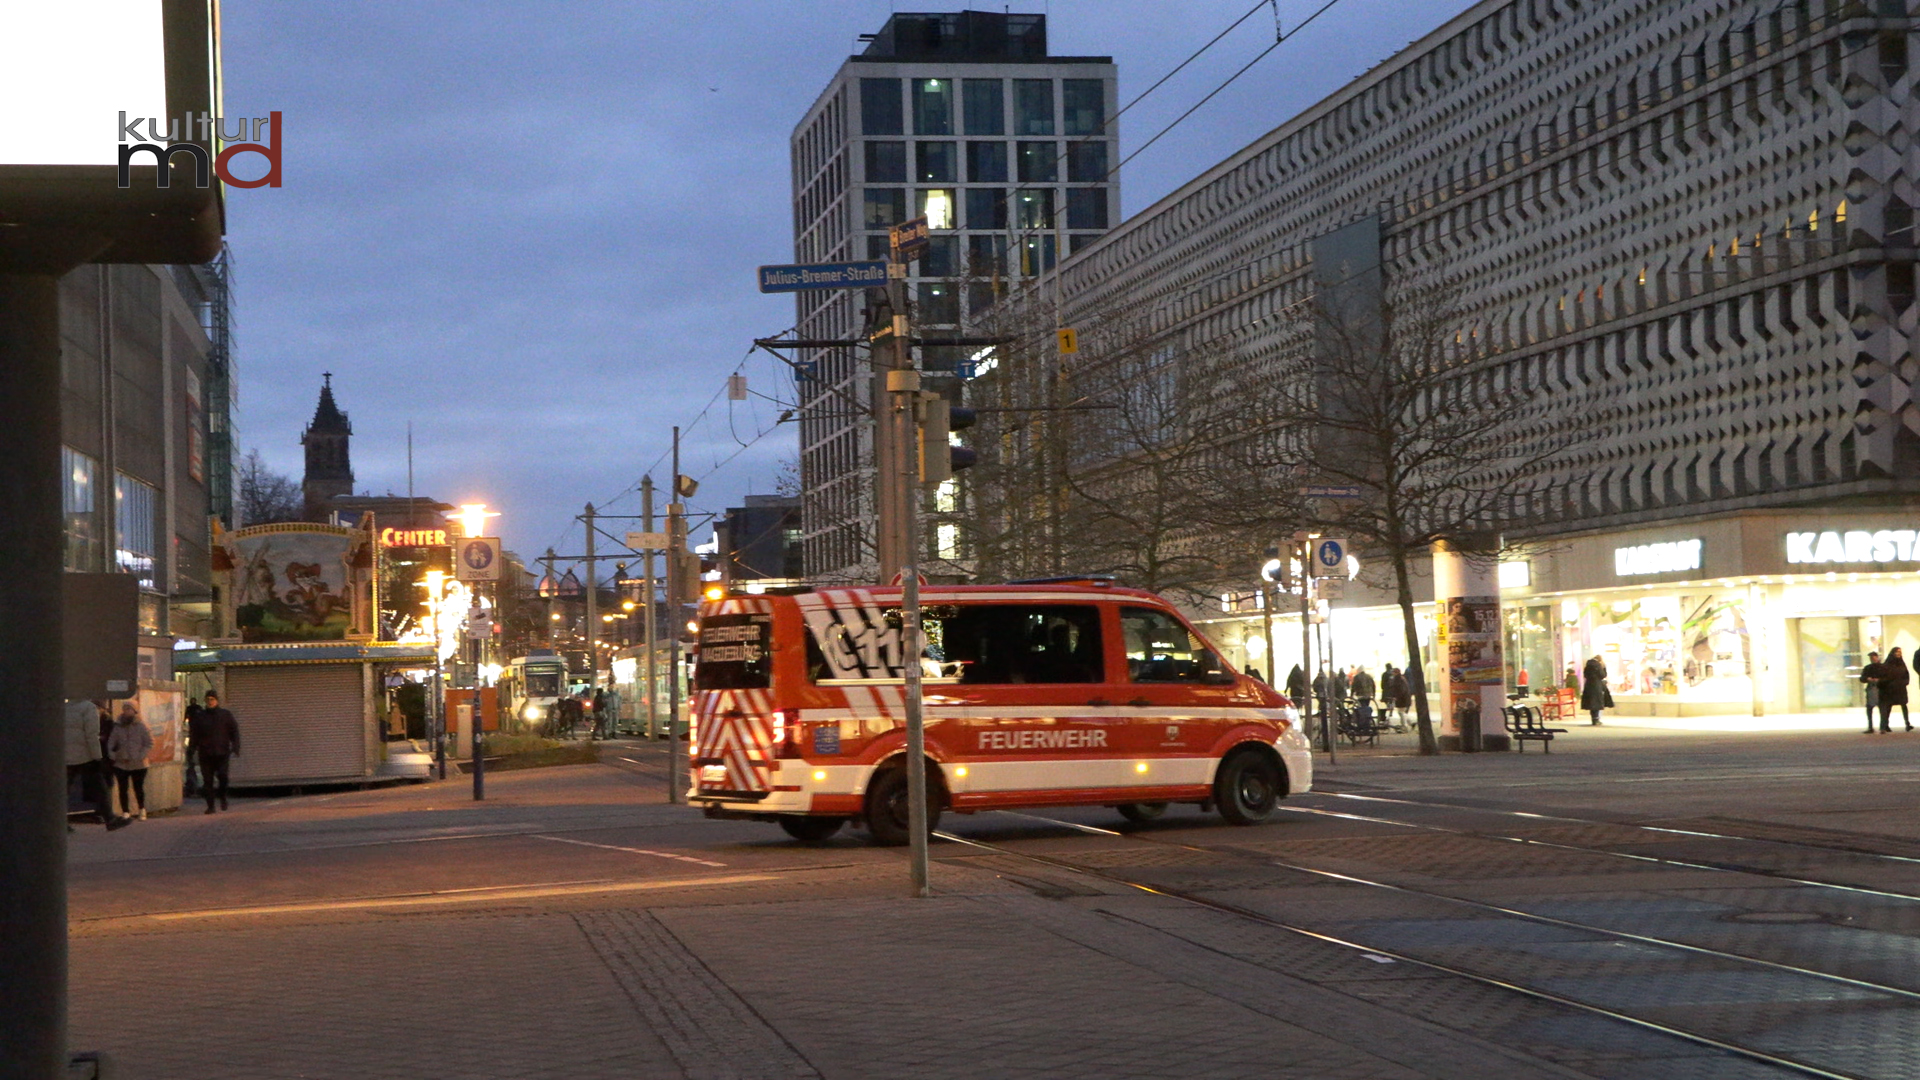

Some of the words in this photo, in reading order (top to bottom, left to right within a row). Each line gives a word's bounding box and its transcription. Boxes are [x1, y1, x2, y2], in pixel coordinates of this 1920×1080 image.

[764, 265, 885, 286] Julius-Bremer-Straße
[1063, 333, 1071, 348] 1
[381, 527, 447, 547] CENTER
[467, 570, 490, 579] ZONE
[978, 729, 1108, 750] FEUERWEHR
